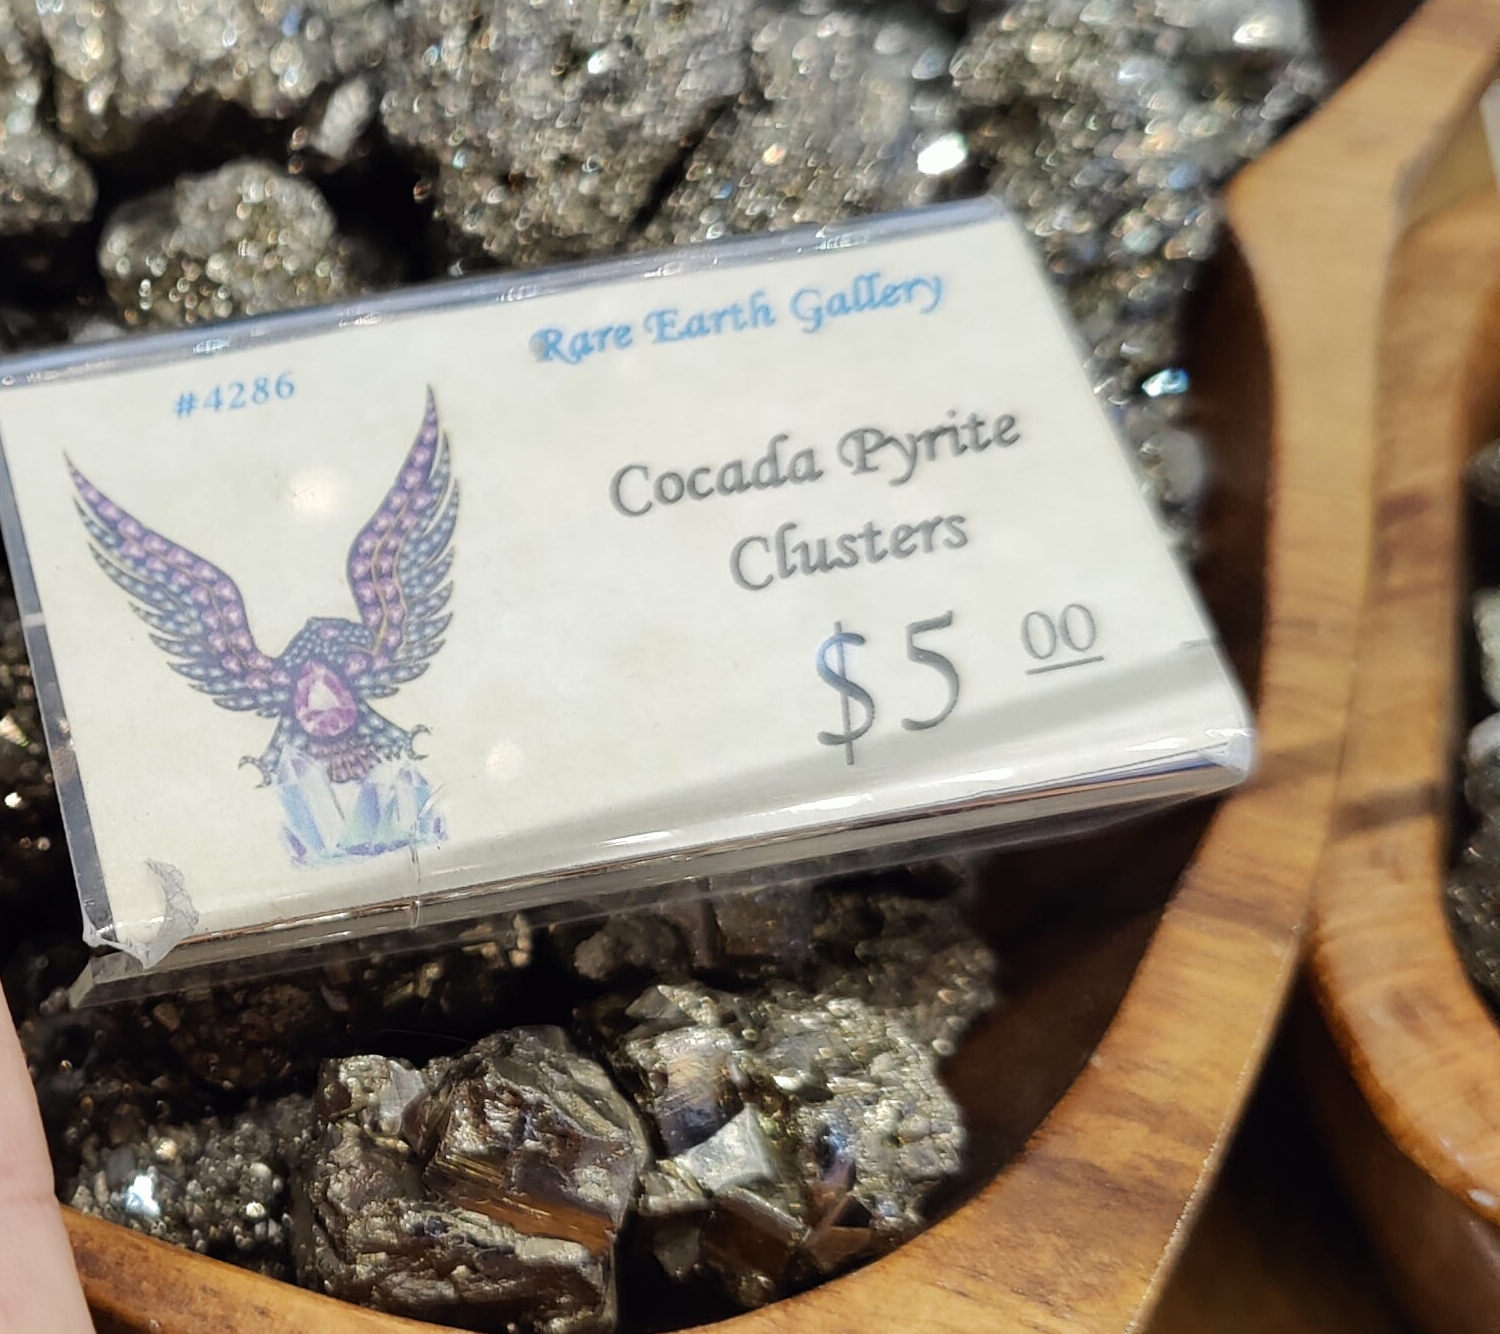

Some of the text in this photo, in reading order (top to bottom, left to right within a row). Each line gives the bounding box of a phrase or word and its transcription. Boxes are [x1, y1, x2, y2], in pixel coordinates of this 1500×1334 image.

[531, 271, 943, 364] Rare Earth Gallery
[174, 372, 296, 418] #4286
[610, 408, 1021, 518] Cocada Pyrite
[730, 512, 968, 592] Clusters
[816, 602, 1098, 765] $5 00
